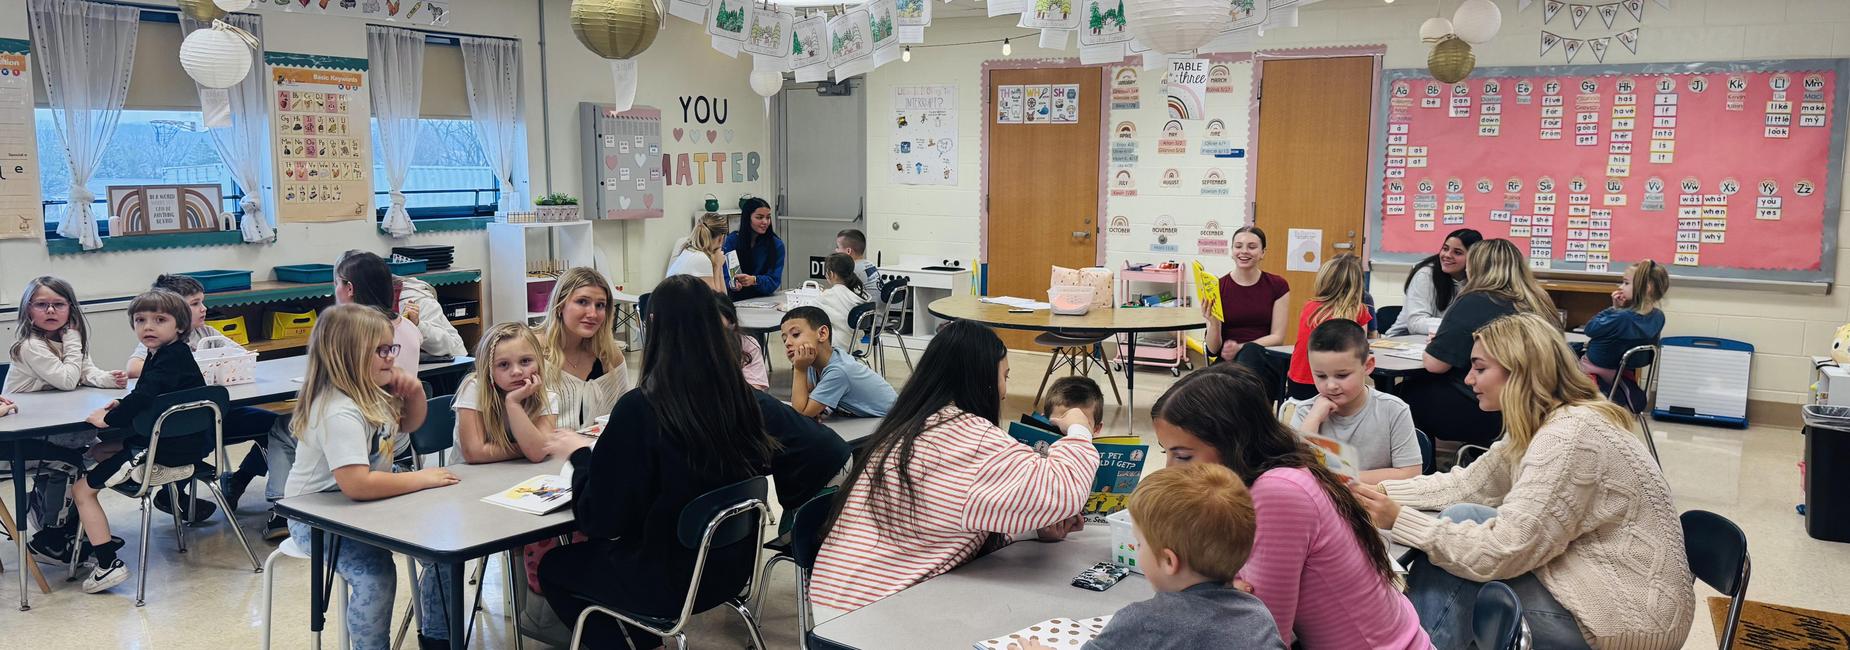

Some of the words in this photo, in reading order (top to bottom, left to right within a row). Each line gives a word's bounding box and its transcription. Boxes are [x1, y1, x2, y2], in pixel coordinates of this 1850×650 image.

[1548, 2, 1638, 17] WORD
[1544, 36, 1633, 50] WALL
[1174, 63, 1202, 71] TABLE
[1179, 71, 1206, 84] three
[1546, 83, 1558, 92] Ff
[1581, 82, 1595, 93] Gg
[1619, 83, 1632, 91] Hh
[1662, 81, 1670, 90] Ii
[1692, 80, 1704, 92] Jj
[1730, 80, 1743, 89] Kk
[1775, 79, 1785, 88] Ll
[1805, 79, 1823, 87] Mm
[1000, 89, 1010, 97] TH
[1054, 88, 1064, 97] SH
[1395, 87, 1408, 95] Aa
[1427, 85, 1439, 94] Bb
[1454, 86, 1467, 94] Cc
[1485, 84, 1498, 93] Dd
[1518, 84, 1529, 93] Ee
[679, 96, 727, 124] YOU
[1805, 116, 1818, 124] my
[1390, 182, 1402, 190] Nn
[1419, 183, 1432, 192] Oo
[1448, 182, 1459, 192] Pp
[1478, 182, 1490, 192] Qq
[1508, 182, 1520, 191] Rr
[1539, 182, 1552, 191] Ss
[1573, 181, 1582, 190] Tt
[1607, 182, 1620, 190] Uu
[1648, 182, 1660, 191] Vv
[1682, 181, 1699, 190] Ww
[1723, 183, 1736, 192] Xx
[1762, 182, 1774, 194] Yy
[1797, 184, 1810, 193] Zz
[1705, 232, 1721, 240] why
